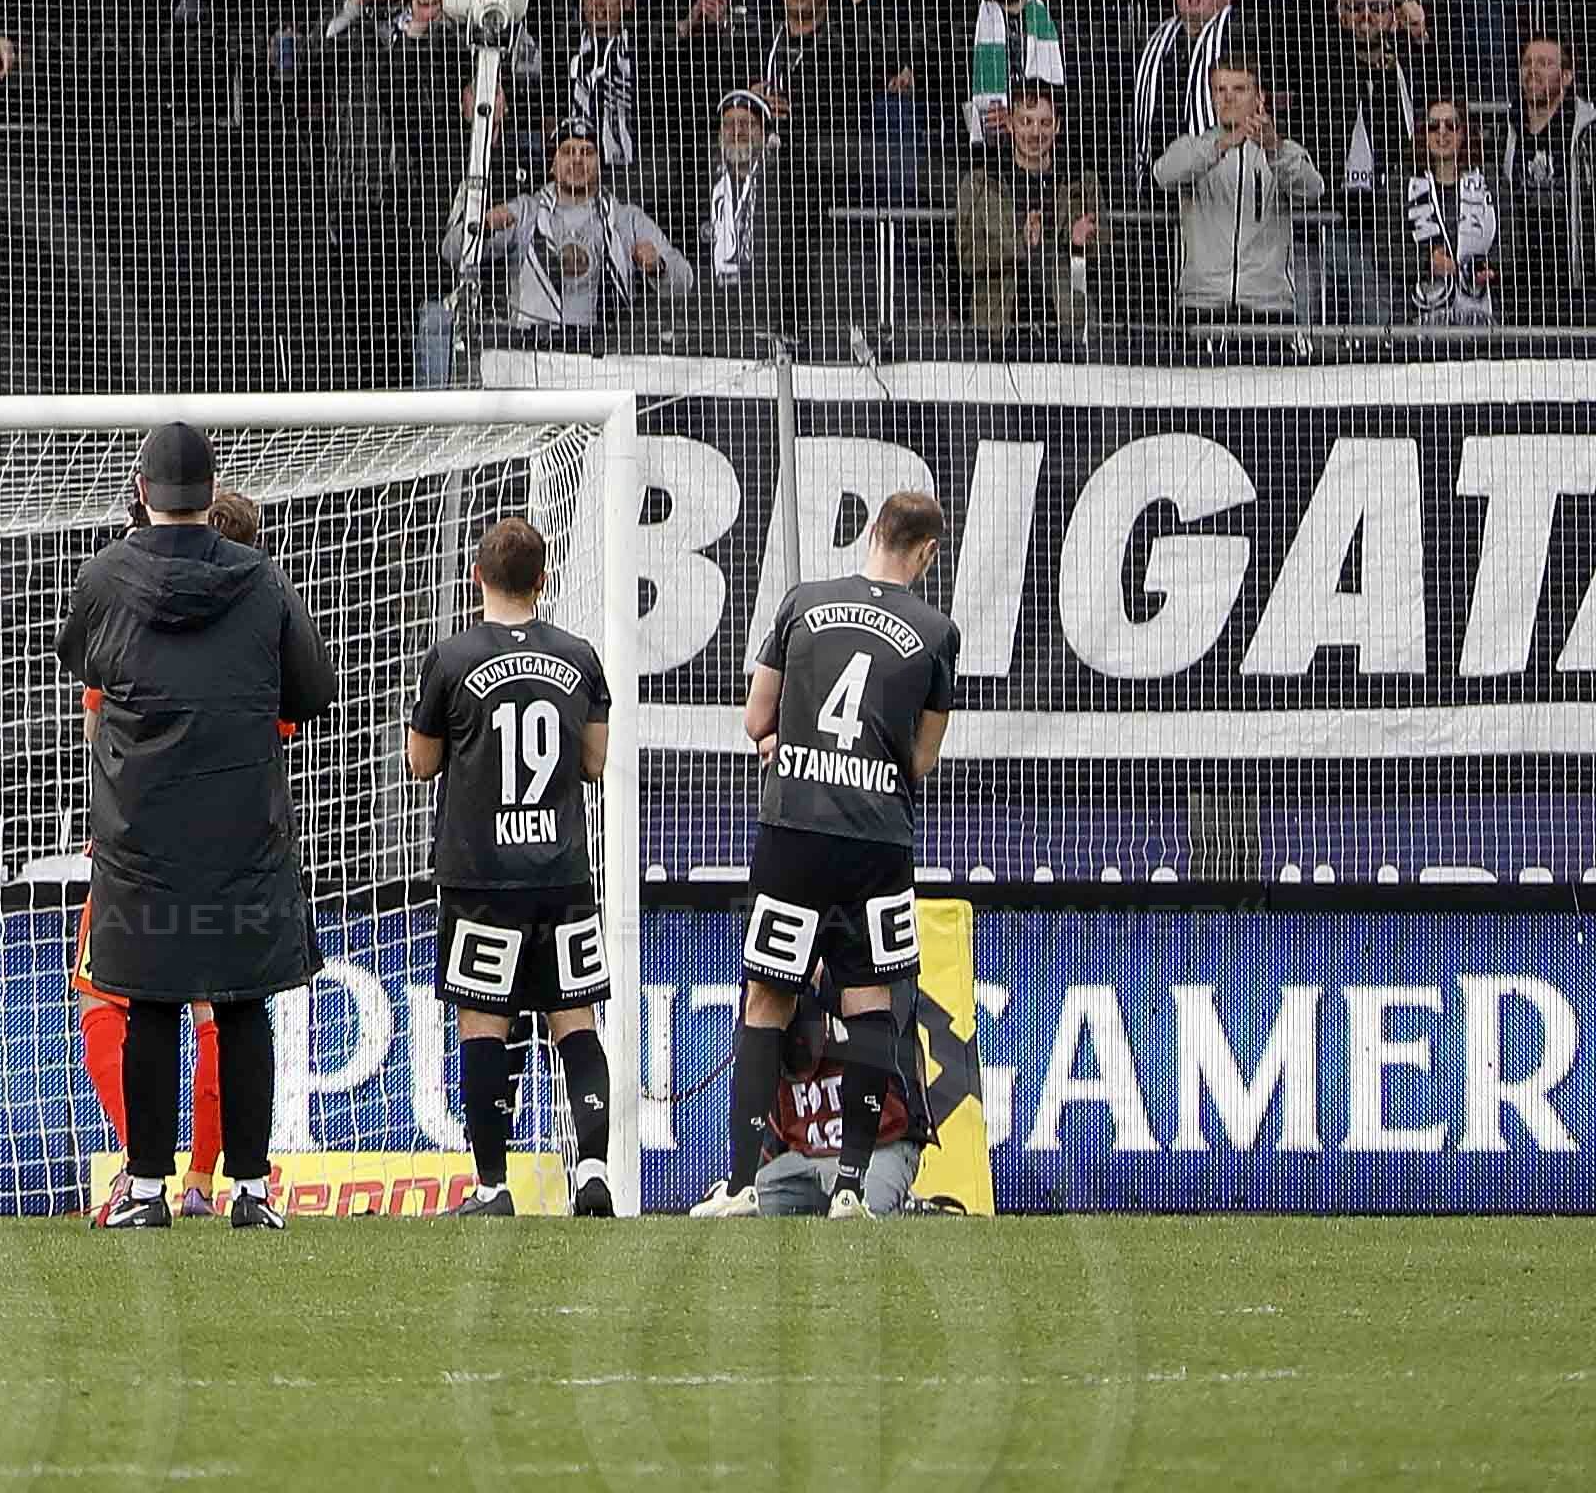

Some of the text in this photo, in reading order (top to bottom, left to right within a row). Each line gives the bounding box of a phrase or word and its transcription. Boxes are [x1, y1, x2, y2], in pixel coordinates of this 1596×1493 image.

[816, 608, 917, 652] PUNTIGAMER
[476, 658, 573, 691] PUNTIGAMER
[817, 651, 872, 751] 4
[492, 700, 561, 805] 19
[777, 744, 898, 793] STANKOVIC
[495, 809, 556, 846] KUEN
